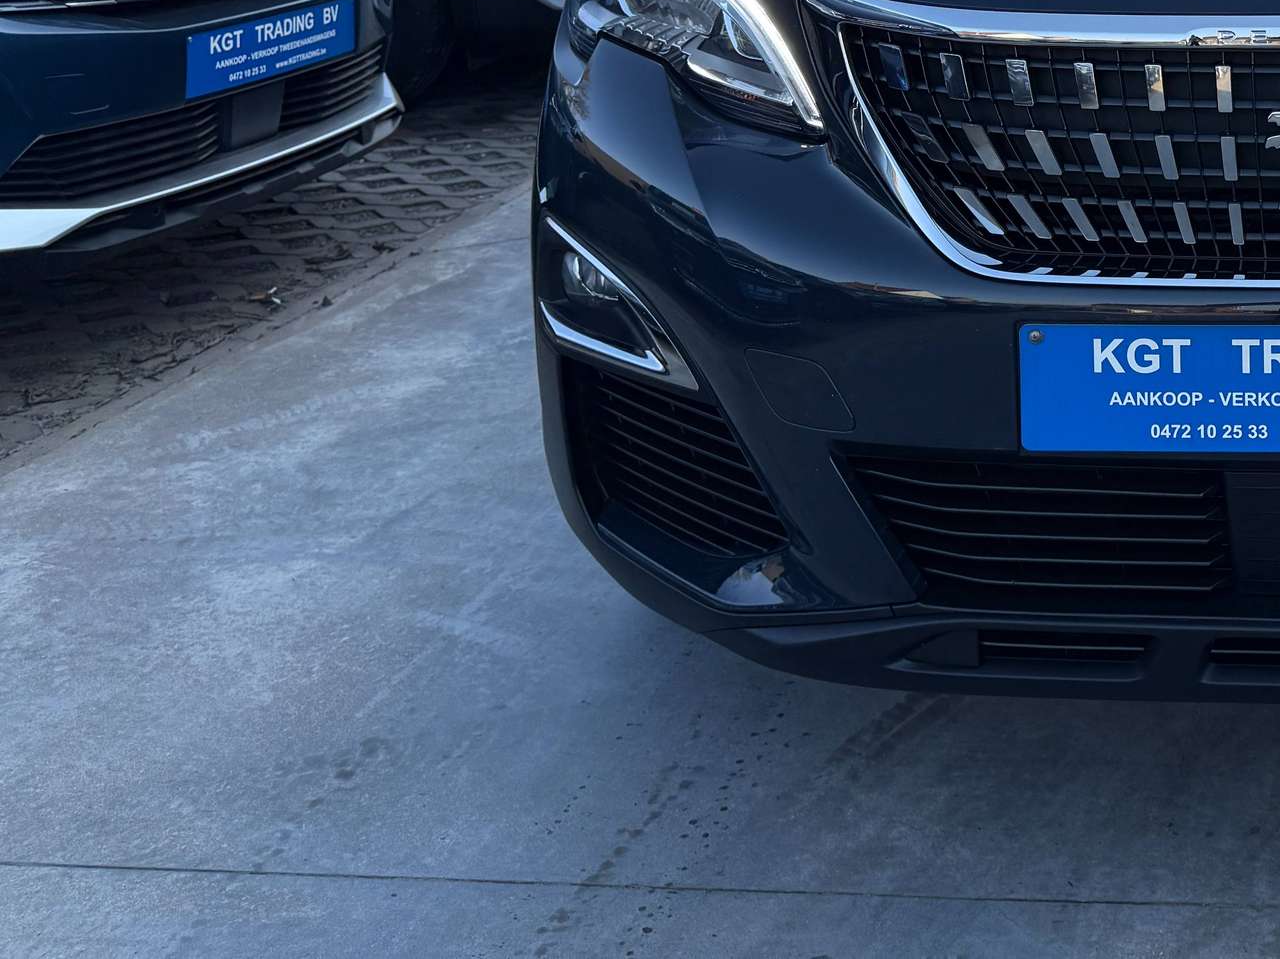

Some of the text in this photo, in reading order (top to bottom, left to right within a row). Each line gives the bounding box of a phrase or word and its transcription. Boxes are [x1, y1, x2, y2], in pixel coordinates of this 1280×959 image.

[210, 4, 339, 54] KGT TRADING BV
[215, 54, 247, 70] AANKOOP
[250, 46, 279, 61] VERKOOP
[1093, 338, 1191, 374] KGT
[1109, 391, 1202, 406] AANKOOP
[1150, 424, 1190, 439] 0472
[1197, 424, 1216, 439] 10
[1222, 424, 1242, 439] 25
[1248, 424, 1268, 439] 33
